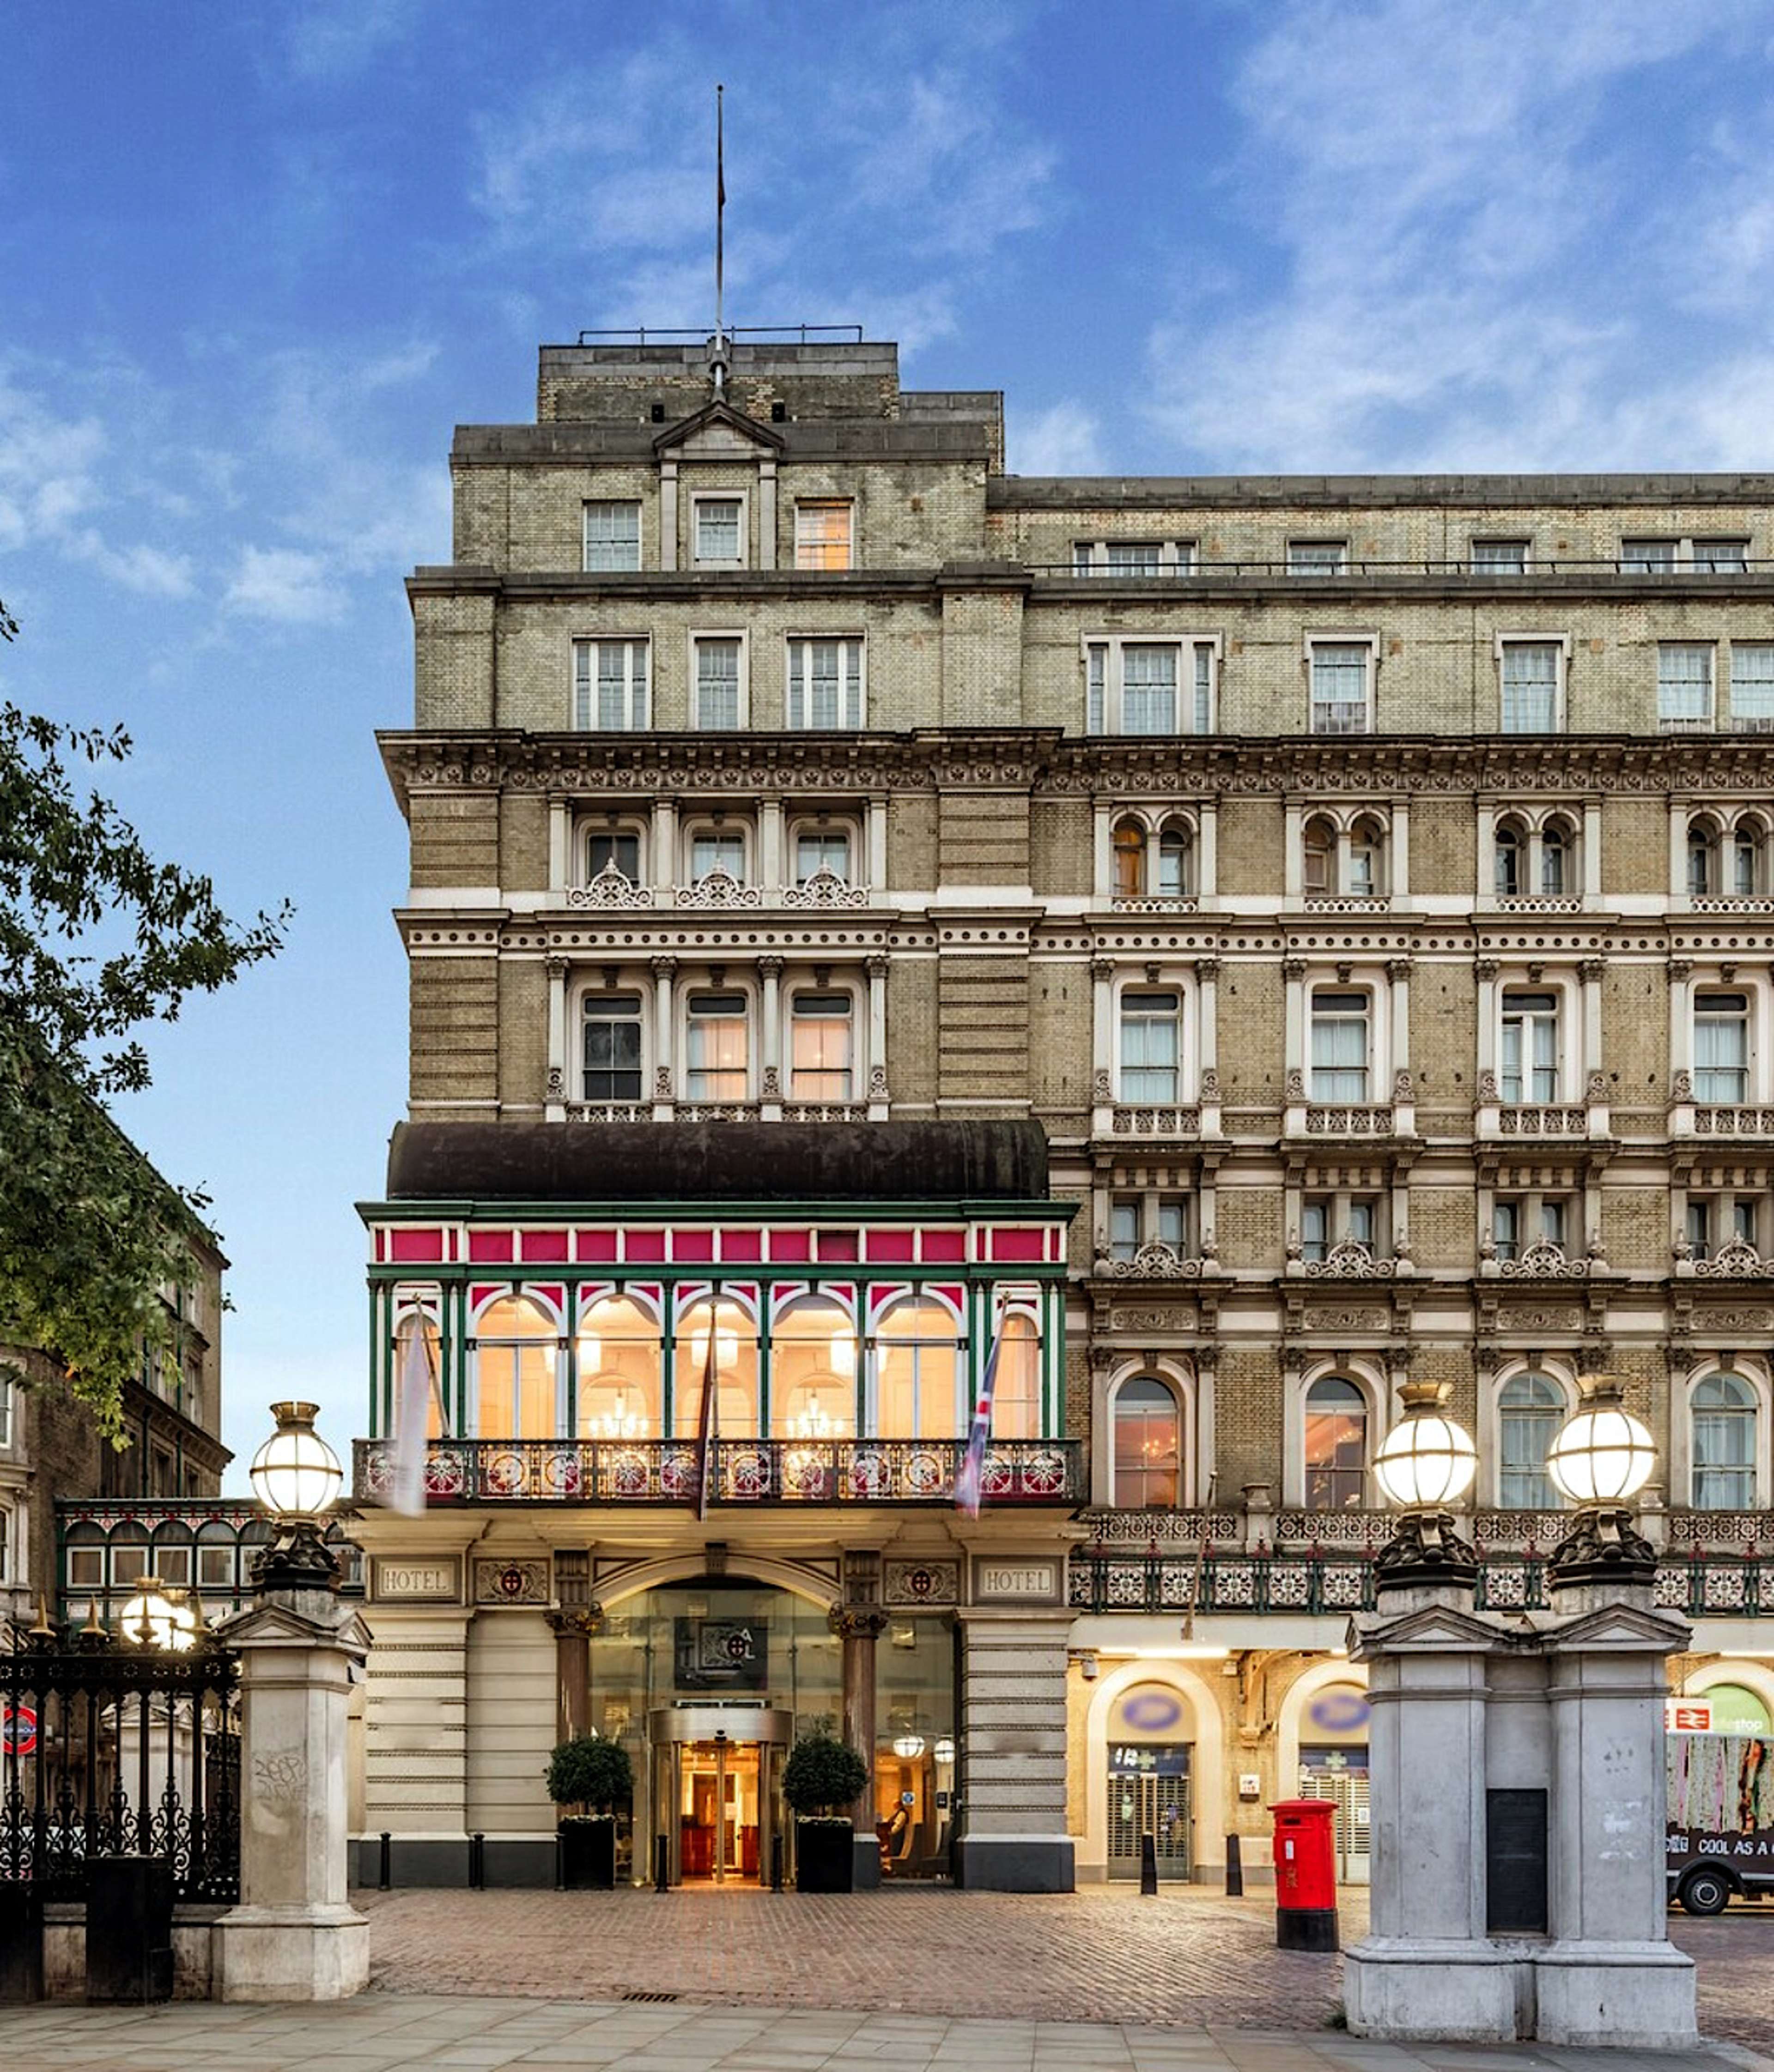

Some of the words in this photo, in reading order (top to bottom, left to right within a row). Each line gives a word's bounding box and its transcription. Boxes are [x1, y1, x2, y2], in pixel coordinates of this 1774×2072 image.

[386, 1570, 447, 1589] HOTEL
[987, 1571, 1049, 1590] HOTEL
[1699, 1838, 1730, 1855] COOL
[1734, 1840, 1754, 1856] AS
[1757, 1841, 1768, 1856] A
